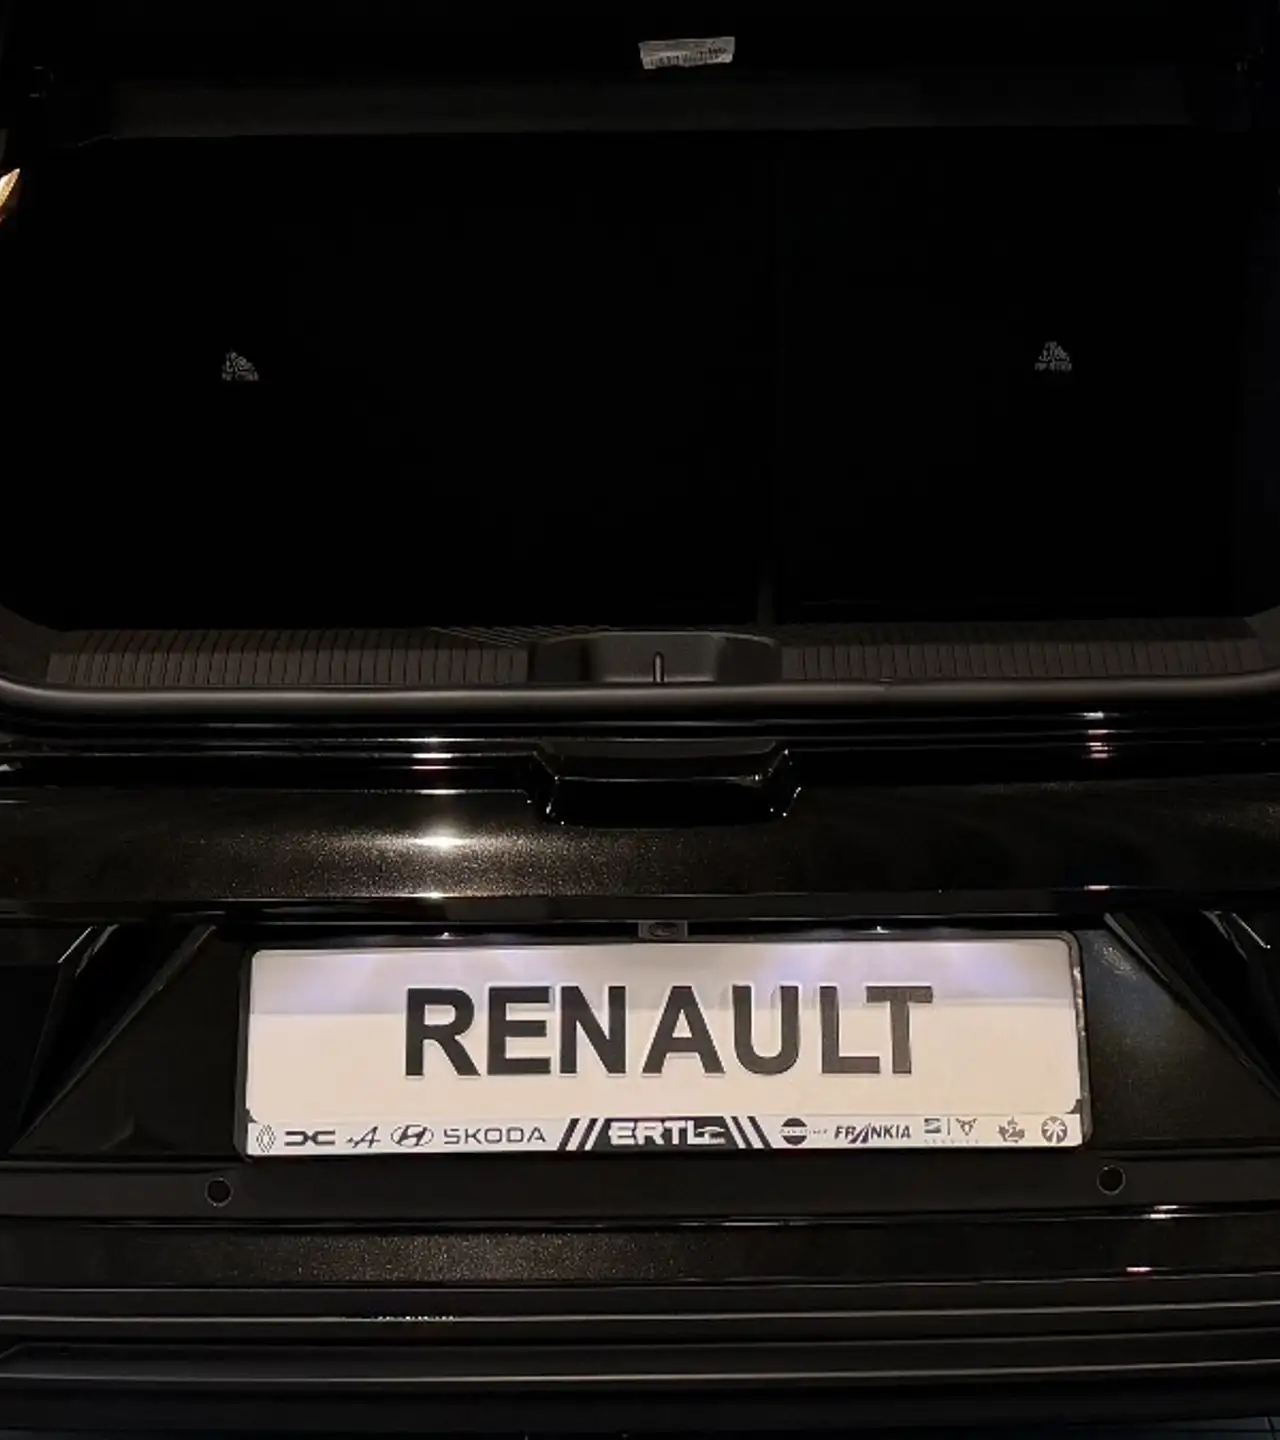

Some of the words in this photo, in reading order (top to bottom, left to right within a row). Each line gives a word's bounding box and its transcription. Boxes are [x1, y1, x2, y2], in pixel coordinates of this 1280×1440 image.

[405, 984, 934, 1077] RENAULT
[443, 1125, 547, 1145] SKODA
[608, 1119, 709, 1145] ERTL
[833, 1122, 912, 1145] FRANKIA
